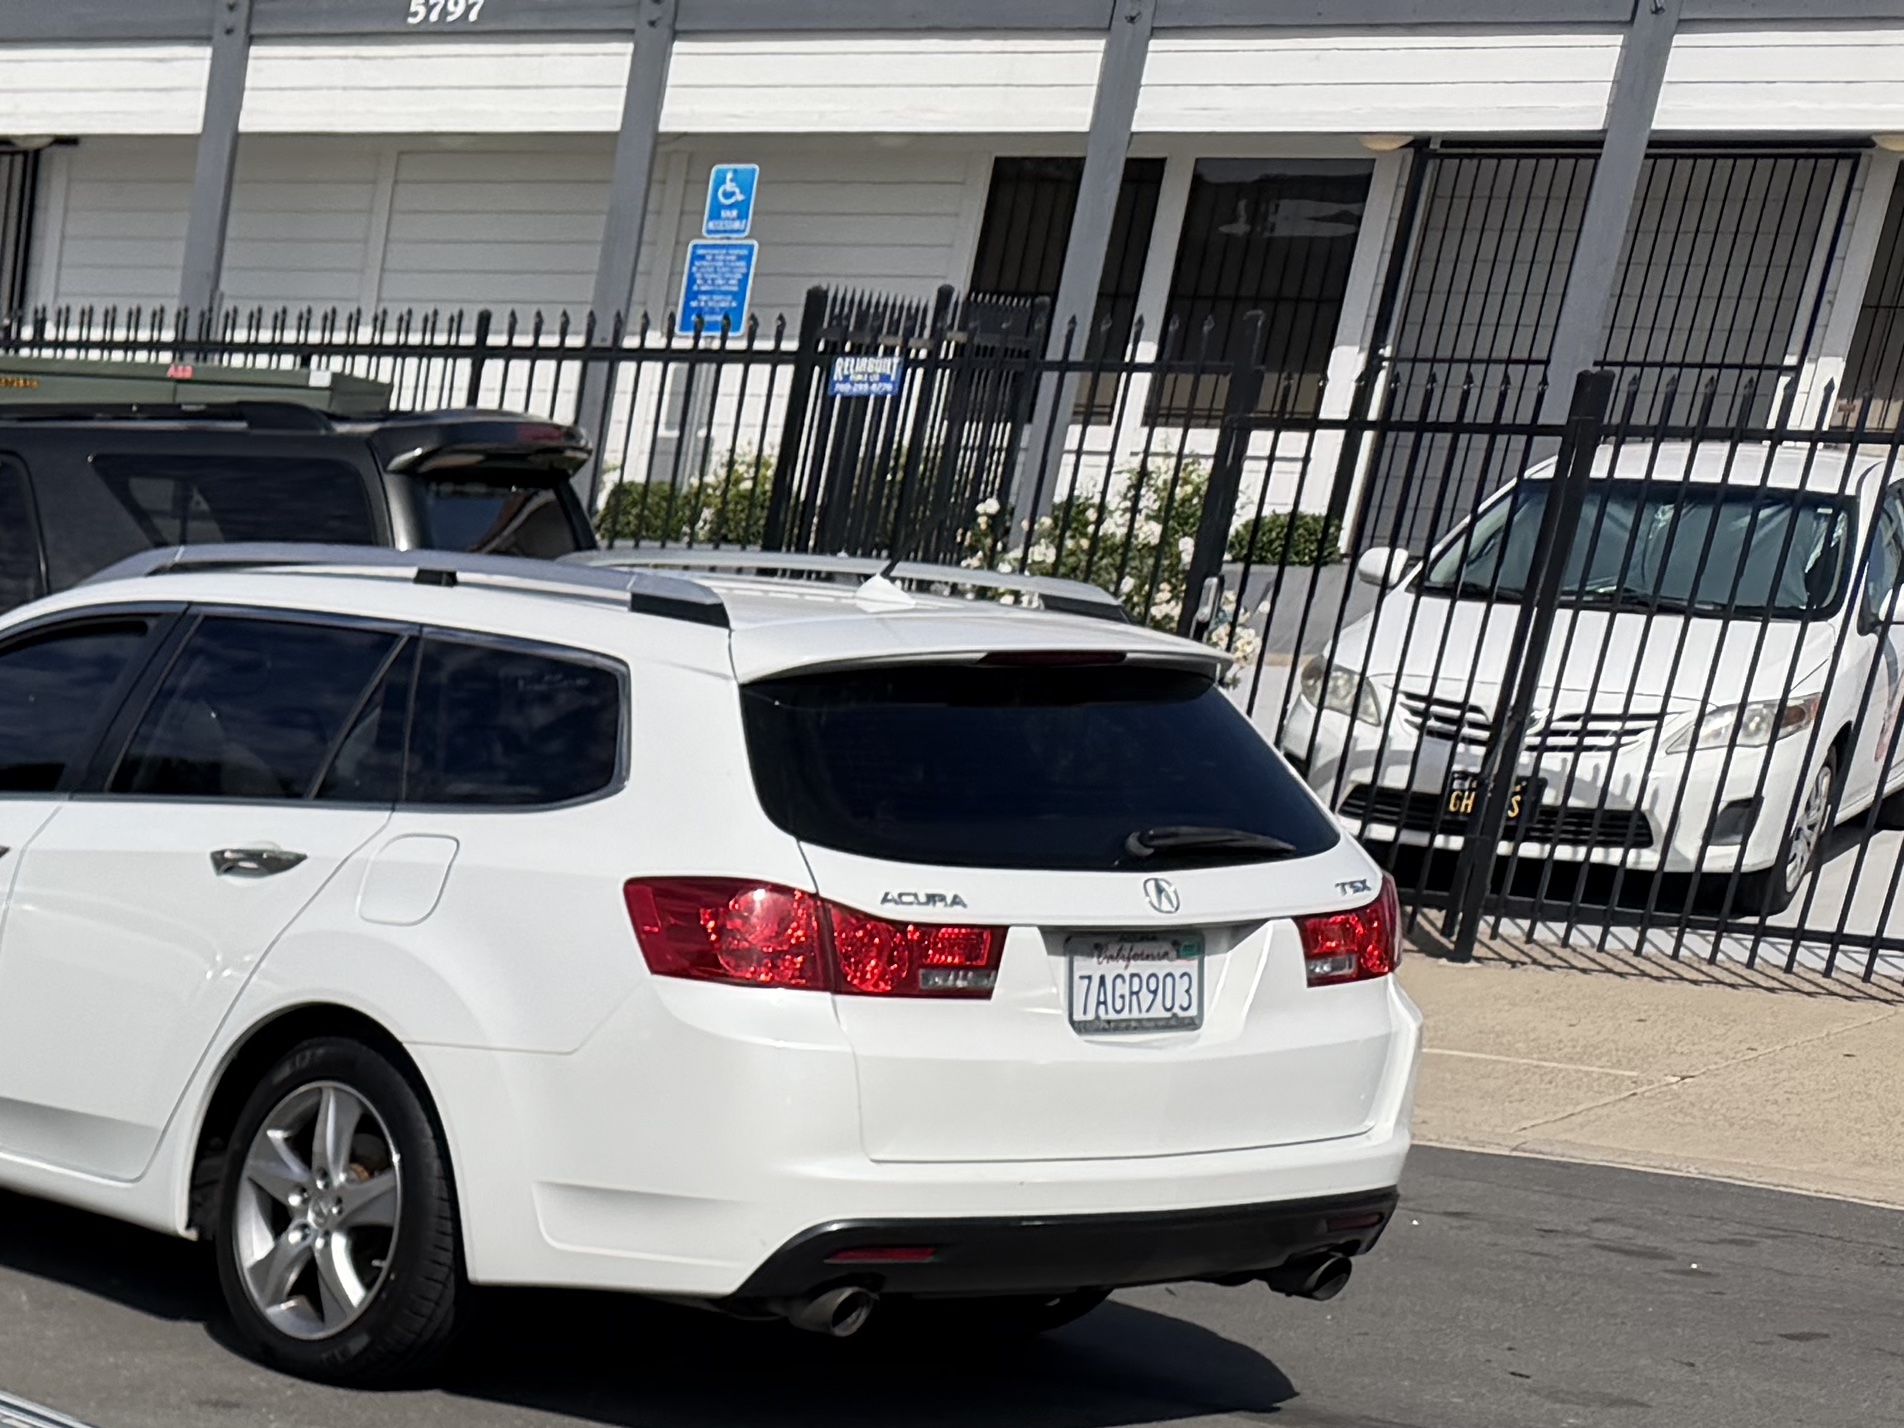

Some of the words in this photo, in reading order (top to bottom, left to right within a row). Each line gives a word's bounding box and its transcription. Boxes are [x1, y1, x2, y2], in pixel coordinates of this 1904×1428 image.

[406, 0, 485, 24] 5797
[1334, 878, 1372, 897] TSX
[879, 891, 968, 909] ACURA
[1096, 943, 1171, 970] California
[1078, 971, 1193, 1016] 7AGR903
